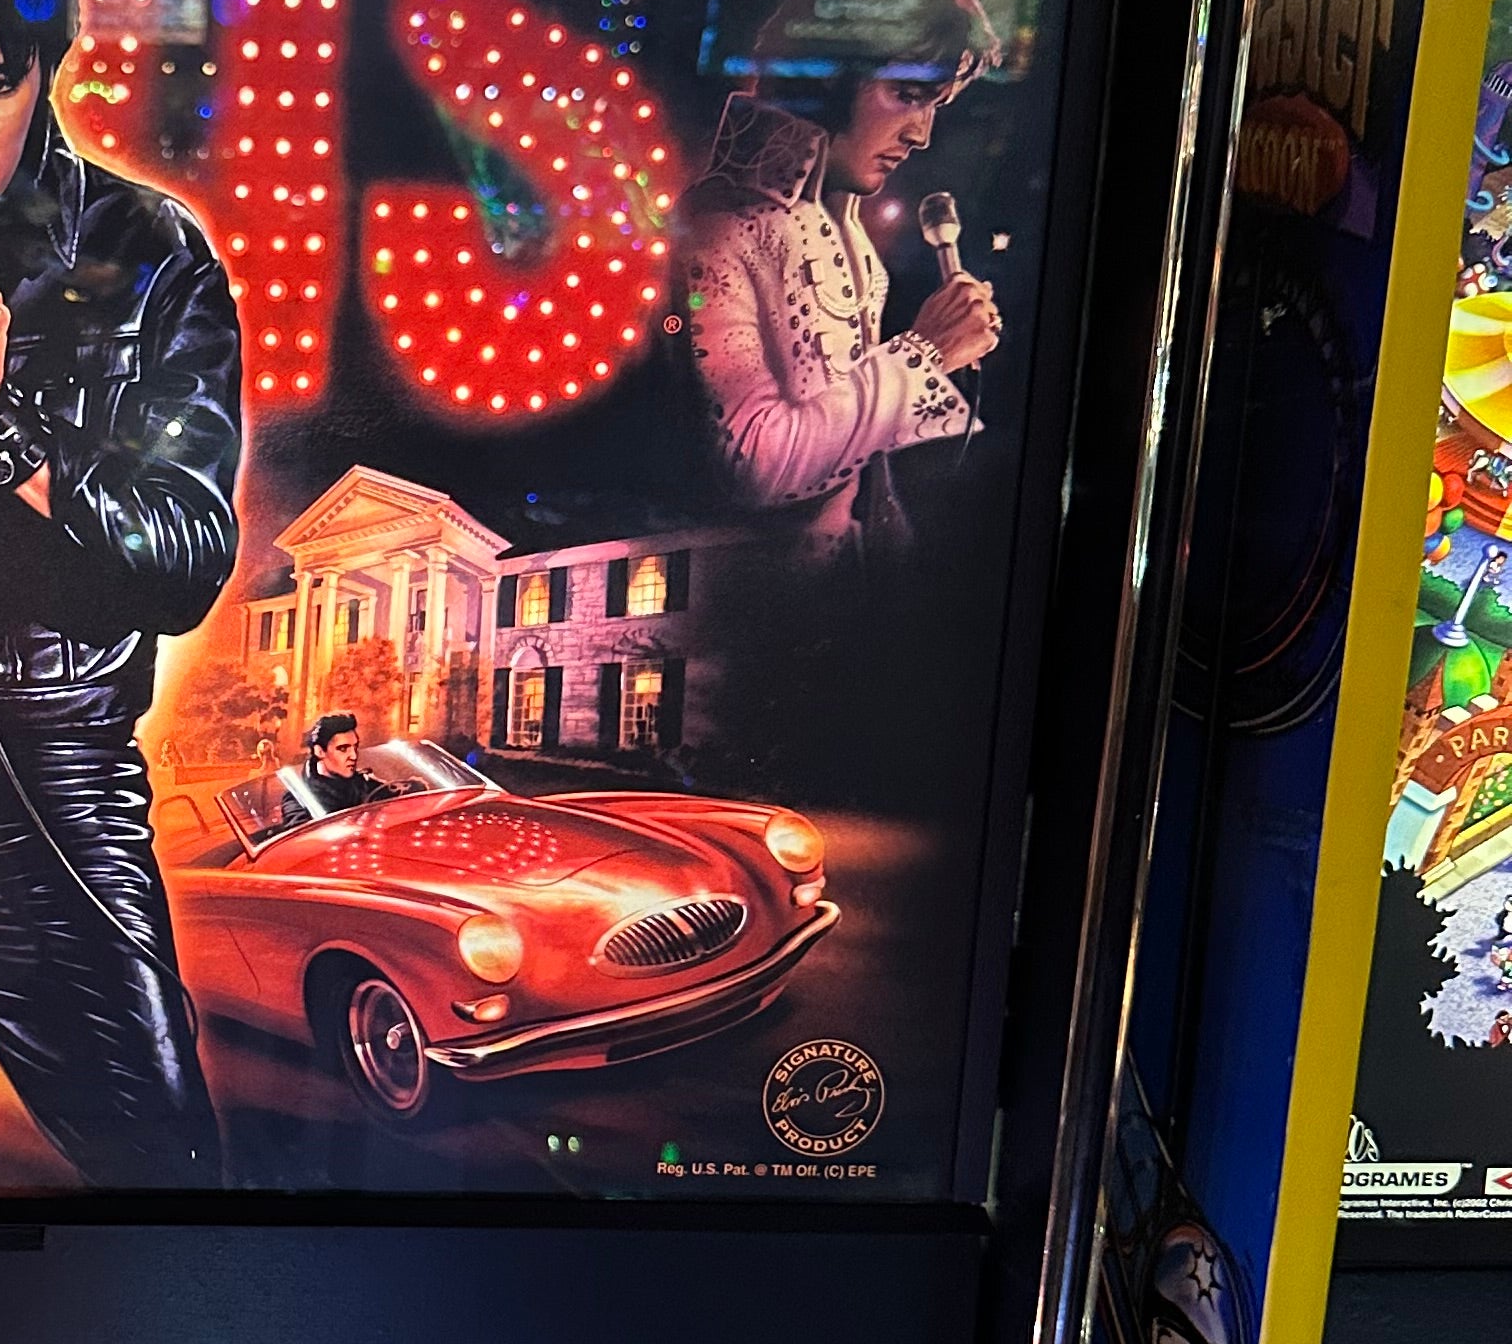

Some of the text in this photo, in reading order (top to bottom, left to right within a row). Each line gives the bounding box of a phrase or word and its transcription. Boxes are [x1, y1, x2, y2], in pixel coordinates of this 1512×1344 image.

[774, 1044, 878, 1084] SIGNATURE
[774, 1118, 868, 1152] PRODUCT
[656, 1162, 687, 1177] Reg.
[691, 1163, 719, 1176] U.S.
[723, 1163, 750, 1176] Pat.
[772, 1164, 793, 1176] TM
[796, 1165, 820, 1177] Off.
[824, 1165, 844, 1179] (C)
[848, 1165, 876, 1177] EPE
